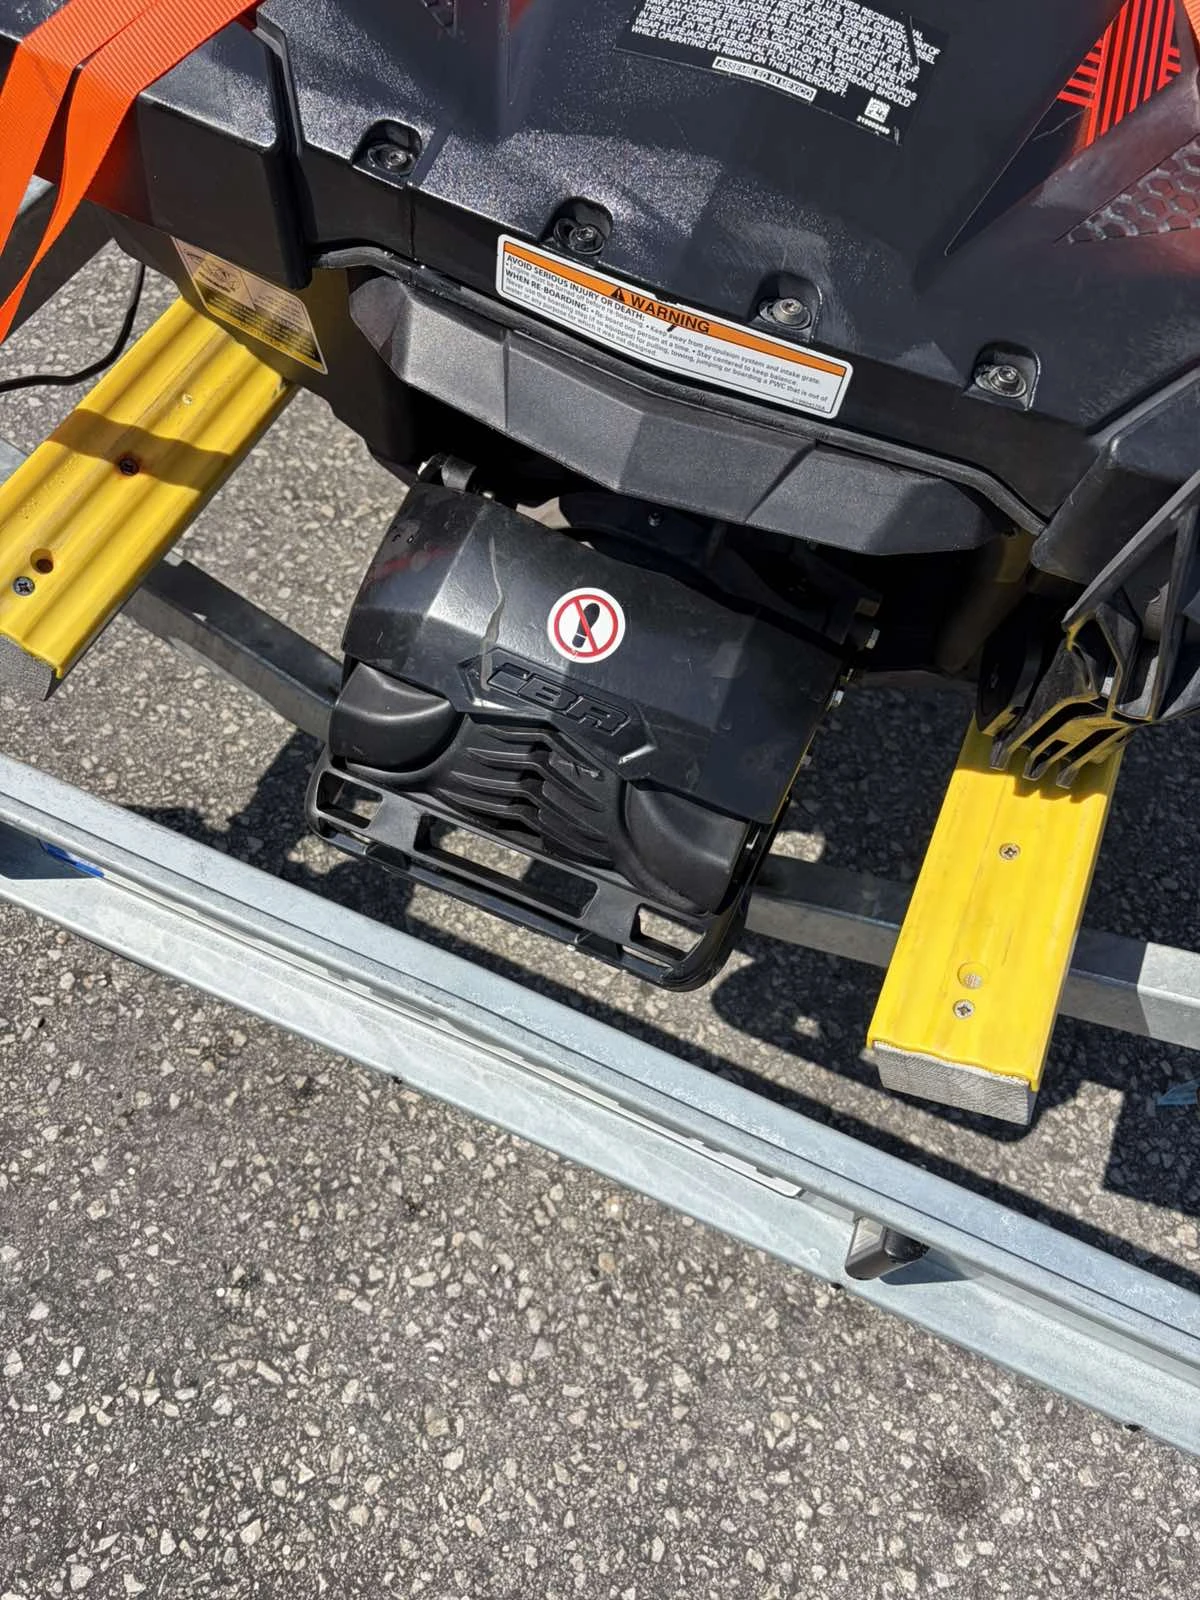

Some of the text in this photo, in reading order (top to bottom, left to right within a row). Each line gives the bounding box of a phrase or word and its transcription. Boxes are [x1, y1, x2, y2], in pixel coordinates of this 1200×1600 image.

[668, 2, 681, 10] AN
[681, 4, 722, 18] ADVERSE
[722, 13, 756, 26] EFFECT
[756, 21, 770, 30] ON
[771, 24, 833, 54] RECREATIONAL
[836, 50, 873, 71] BOATING
[874, 66, 907, 87] SAFETY.
[771, 8, 790, 19] ARE
[791, 13, 850, 43] INAPPLICABLE
[851, 38, 861, 47] IN
[861, 43, 887, 59] LIGHT
[887, 54, 900, 65] OF
[777, 1, 837, 29] REGULATIONS.
[840, 24, 858, 37] CGB
[812, 4, 842, 22] GUARD
[842, 17, 882, 40] EXEMPTS
[884, 34, 903, 49] THIS
[843, 8, 873, 25] COAST
[873, 22, 902, 40] GUARD
[929, 46, 940, 55] OF
[632, 24, 847, 98] WHILE OPERATING OR RIDING ON THIS WATERCRAFT.
[635, 17, 660, 29] WEAR
[717, 37, 765, 55] (PERSONAL
[766, 49, 814, 73] FLOTATION
[814, 68, 848, 89] DEVICE)
[638, 10, 648, 18] IN
[649, 12, 681, 25] EFFECT
[682, 20, 695, 29] ON
[696, 24, 713, 34] THE
[714, 27, 737, 40] DATE
[738, 33, 751, 41] OF
[817, 60, 832, 73] ALL
[834, 67, 875, 91] PERSONS
[876, 87, 910, 107] SHOULD
[644, 3, 917, 101] THIS BOAT COMPLIES WITH U.S. COAST GUARD SAFETY STANDARDS
[767, 16, 786, 26] AND
[789, 20, 810, 34] THAT
[811, 29, 828, 42] THE
[829, 37, 878, 64] EXEMPTION
[879, 60, 897, 74] WILL
[899, 69, 918, 82] NOT
[717, 60, 812, 96] ASSEMBLED IN MEXICO
[506, 269, 530, 285] WHEN
[531, 280, 589, 312] RE-BOARDING:
[507, 255, 645, 321] AVOID SERIOUS INJURY OR DEATH:
[631, 294, 710, 333] WARNING
[769, 380, 786, 389] PWC
